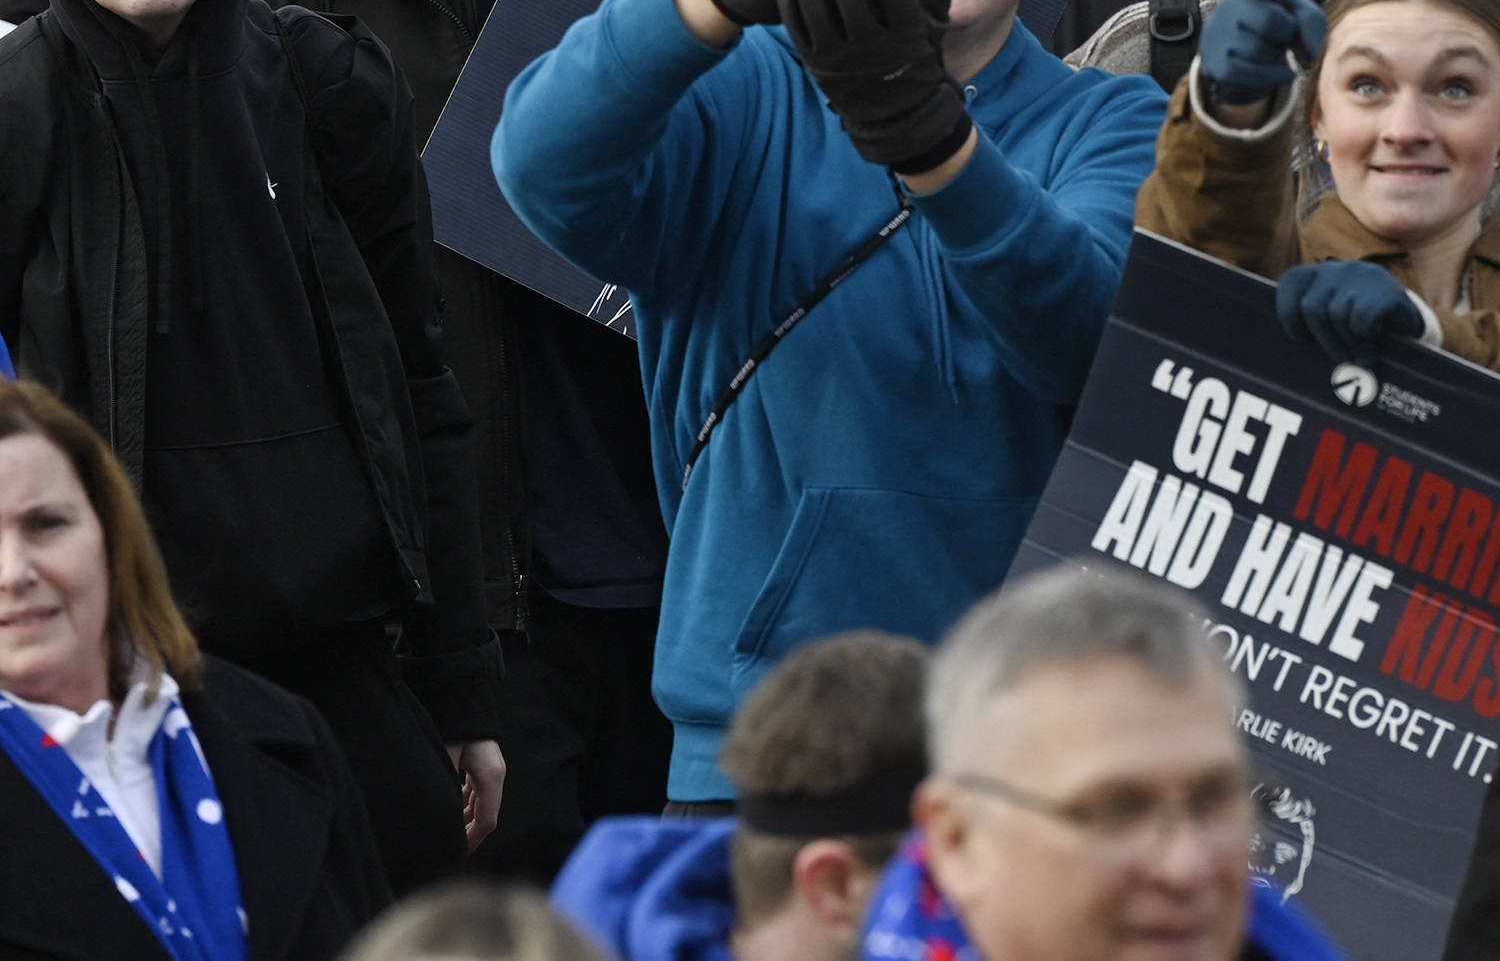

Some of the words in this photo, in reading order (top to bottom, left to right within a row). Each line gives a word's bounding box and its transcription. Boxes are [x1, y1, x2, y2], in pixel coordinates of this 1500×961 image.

[1091, 460, 1234, 589] AND
[1221, 514, 1395, 662] HAVE
[1203, 619, 1303, 692] ON'T
[1299, 665, 1455, 759] REGRET
[1453, 731, 1498, 784] IT.
[1281, 728, 1333, 766] KIRK
